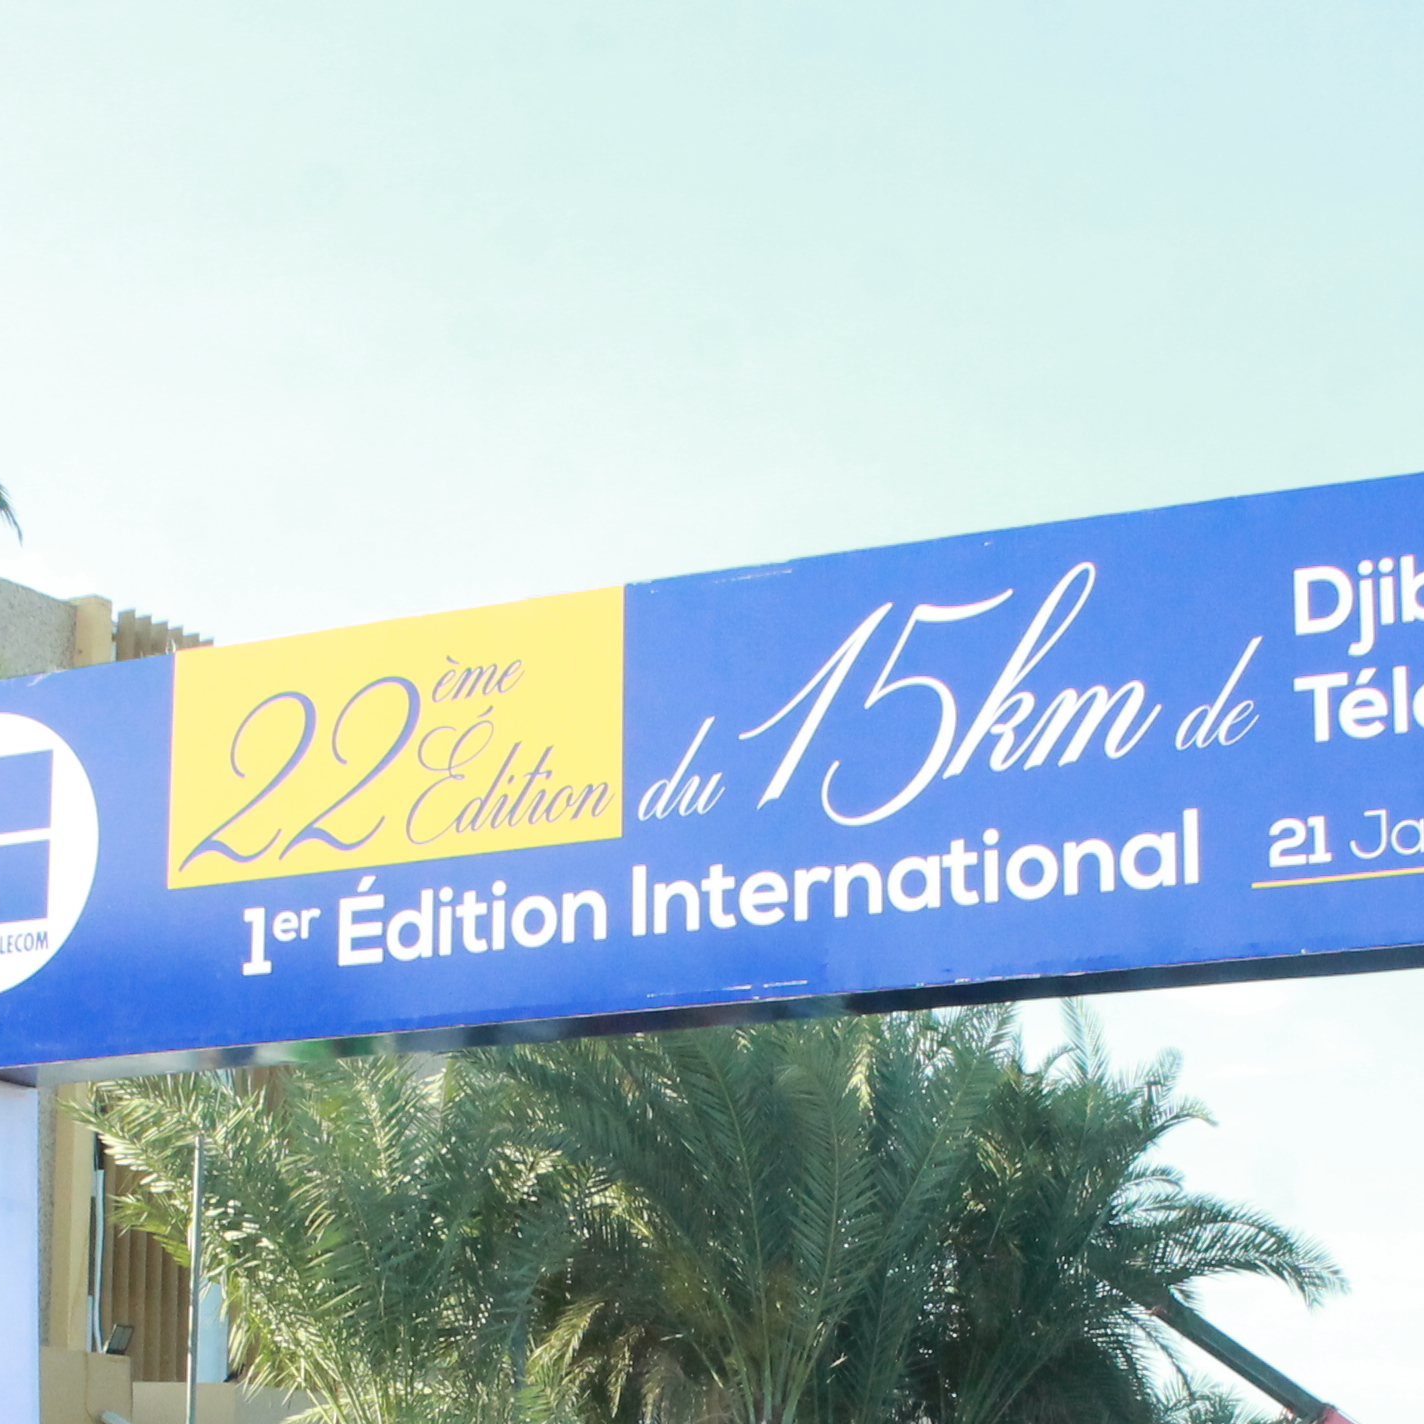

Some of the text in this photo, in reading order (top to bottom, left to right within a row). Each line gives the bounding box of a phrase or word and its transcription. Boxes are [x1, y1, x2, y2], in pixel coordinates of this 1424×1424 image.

[406, 705, 616, 845] Édition
[637, 716, 726, 822] du
[1175, 635, 1264, 751] de
[336, 874, 608, 968] Édition
[631, 807, 1201, 938] International
[1267, 815, 1333, 868] 21
